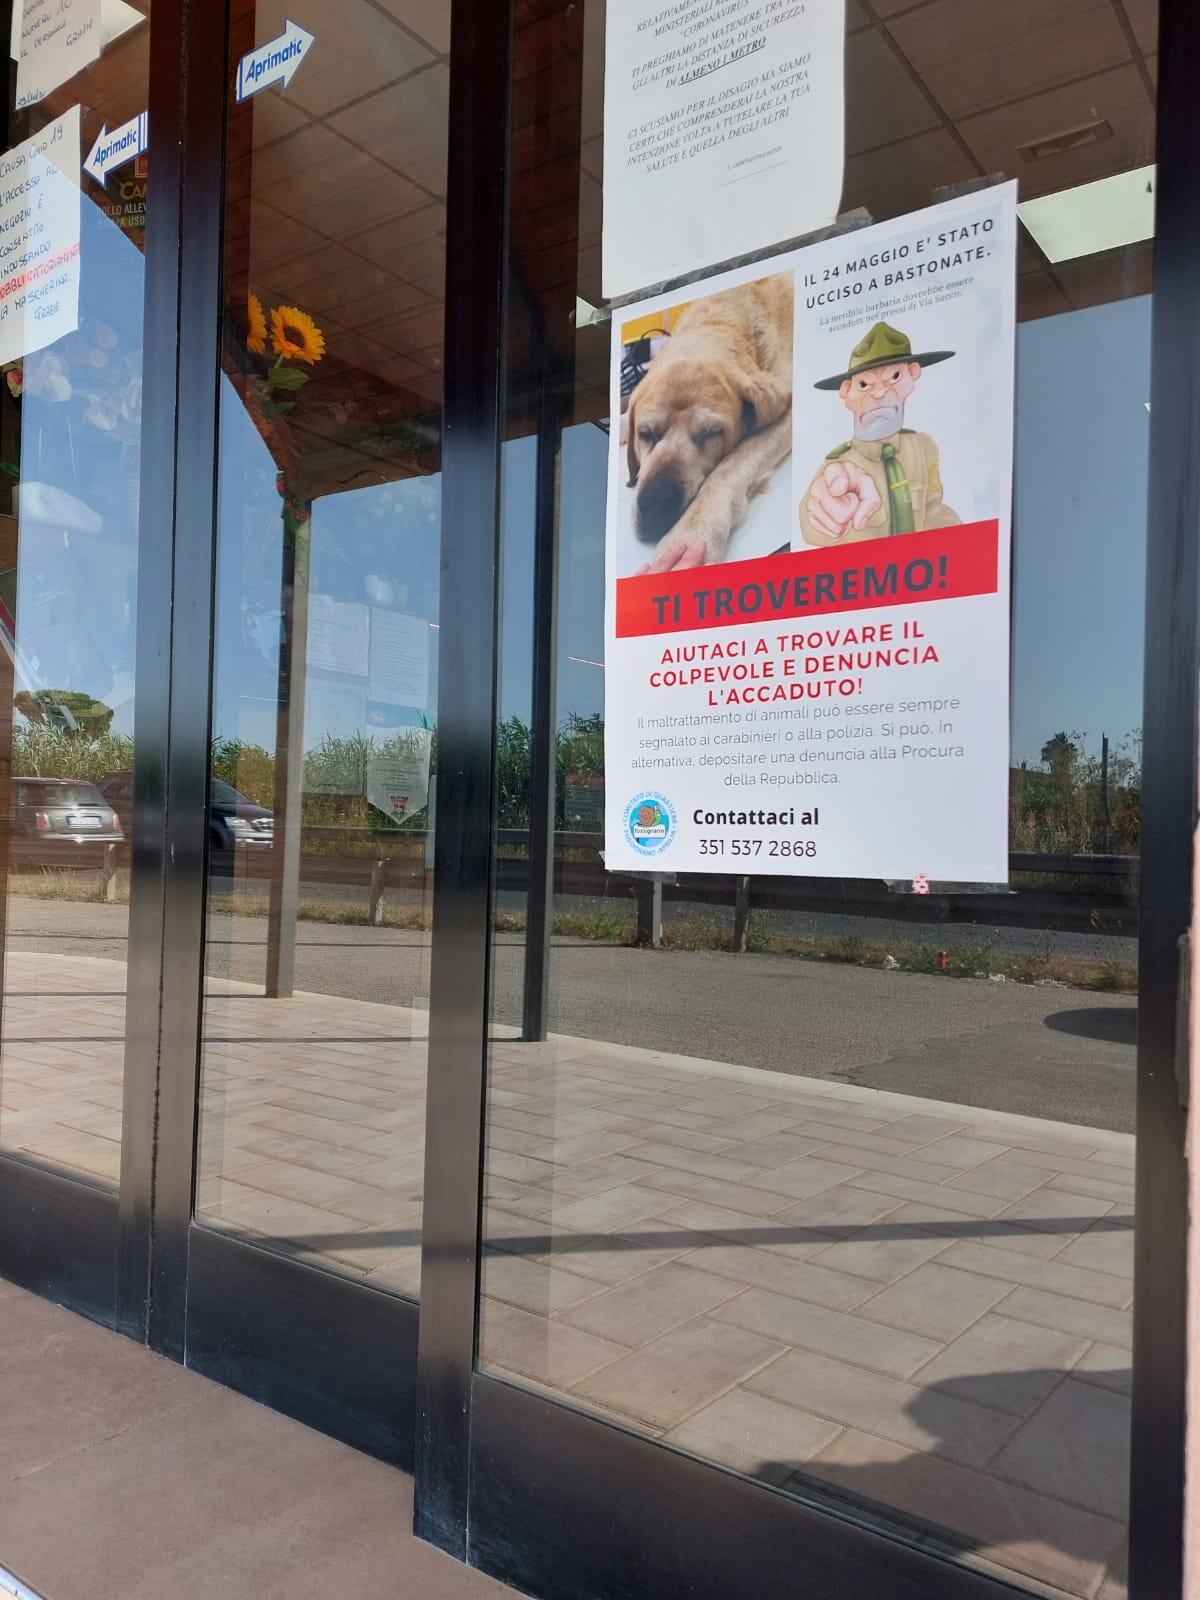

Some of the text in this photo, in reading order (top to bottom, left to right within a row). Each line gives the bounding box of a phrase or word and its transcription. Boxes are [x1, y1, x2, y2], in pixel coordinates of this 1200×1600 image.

[245, 38, 302, 83] Aprimatic
[632, 66, 640, 78] TI
[641, 41, 697, 74] PREGHIAMO
[699, 34, 709, 48] DI
[711, 9, 761, 41] MATENERE
[632, 4, 805, 90] GLI ALTRI LA DISTANZA DI SICUREZZA
[666, 77, 677, 89] DI
[679, 58, 720, 83] ALMENO
[730, 36, 766, 59] METRO
[627, 53, 812, 140] CI SCUSIAMO PER IL DISAGIO MA SIAMO
[629, 69, 808, 153] CERTI CHE COMPRENDERAI LA NOSTRA
[93, 128, 137, 166] Aprimatic
[627, 138, 681, 167] INTENZIONE
[683, 125, 711, 144] VOLTA
[723, 99, 772, 128] TUTELARE
[775, 93, 788, 106] LA
[791, 83, 810, 100] TUA
[645, 153, 680, 174] SALUTE
[689, 133, 725, 158] QUELLA
[728, 119, 760, 140] DEGLI
[761, 107, 790, 128] ALTRI
[0, 155, 26, 178] CAUSA
[50, 124, 63, 144] 19
[46, 166, 58, 177] AL
[0, 207, 31, 234] NEGOZIO
[0, 223, 44, 258] CONSENTITO
[0, 240, 51, 279] INDOSSANDO
[804, 218, 994, 287] IL 24 MAGGIO E' STATO
[806, 246, 991, 310] UCCISO A BASTONATE.
[0, 304, 8, 320] LA
[818, 276, 975, 327] La terribile barbaria dovrebbe essere
[880, 305, 906, 321] pressi
[908, 301, 917, 311] di
[918, 297, 933, 308] Via
[934, 291, 963, 303] Sacco.
[652, 556, 949, 625] TI TROVEREMO!
[661, 620, 925, 665] AIUTACI A TROVARE IL
[649, 645, 940, 689] COLPEVOLE E DENUNCIA
[637, 698, 961, 729] Il maltrattamento di animali può essere sempre
[707, 677, 864, 707] L'ACCADUTO!
[631, 744, 965, 769] alternativa, depositare una denuncia alla Procura
[639, 735, 697, 750] segnalato
[699, 733, 710, 746] ai
[713, 729, 781, 745] carabinieri
[784, 731, 794, 742] o
[797, 727, 822, 741] alla
[826, 726, 876, 742] polizia.
[881, 722, 895, 737] Si
[939, 720, 953, 734] in
[724, 770, 841, 788] della Repubblica.
[693, 808, 819, 825] Contattaci al
[699, 839, 817, 857] 351 537 2868
